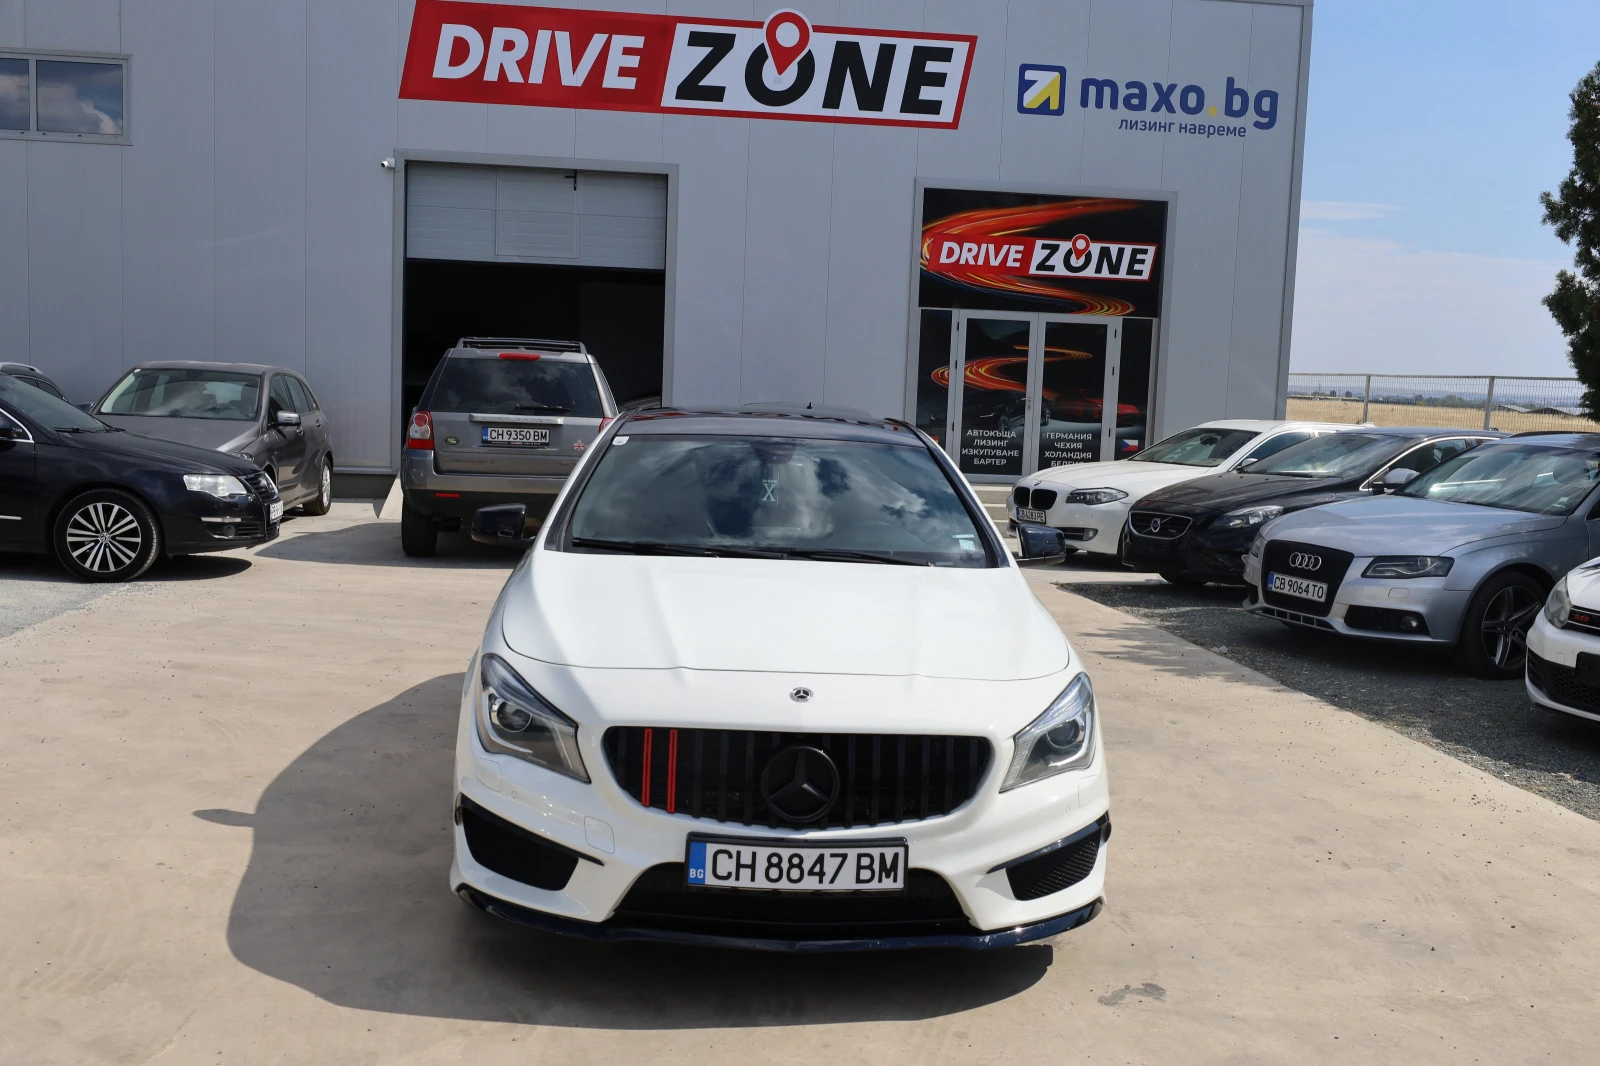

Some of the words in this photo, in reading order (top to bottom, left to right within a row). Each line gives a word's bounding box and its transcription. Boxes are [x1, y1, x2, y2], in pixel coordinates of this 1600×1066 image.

[432, 23, 645, 91] DRIVE
[675, 31, 954, 115] ZONE
[1080, 77, 1279, 130] maxo.bg
[1118, 118, 1176, 133] лизинг
[1178, 120, 1247, 138] навреме
[939, 241, 1025, 268] DRIVE
[1035, 243, 1149, 276] ZONE
[490, 429, 504, 440] CH
[506, 430, 531, 441] 9350
[533, 430, 547, 442] BM
[966, 429, 1017, 438] АВТОКЪЩА
[1046, 432, 1092, 441] ГЕРМАНИЯ
[973, 438, 1009, 447] ЛИЗИНГ
[1054, 441, 1083, 450] ЧЕХИЯ
[962, 448, 1019, 457] ИЗКУПУВАНЕ
[1044, 450, 1092, 460] ХОЛАНДИЯ
[973, 457, 1007, 466] БАРТЕР
[1274, 576, 1286, 590] CB
[1287, 579, 1310, 596] 9064
[712, 849, 757, 883] CH
[764, 852, 848, 884] 8847
[855, 852, 900, 884] BM
[689, 869, 704, 879] BG
